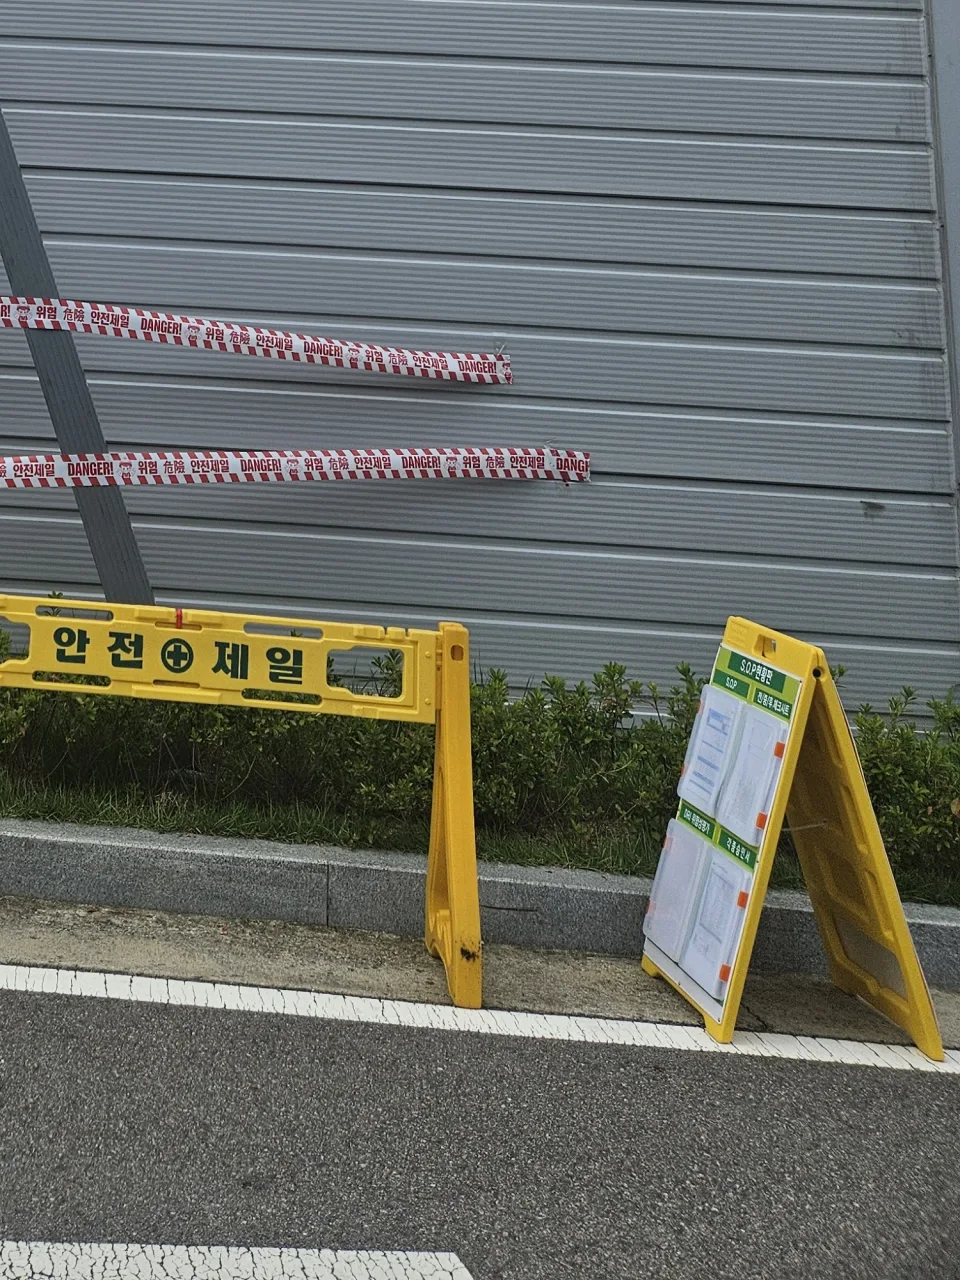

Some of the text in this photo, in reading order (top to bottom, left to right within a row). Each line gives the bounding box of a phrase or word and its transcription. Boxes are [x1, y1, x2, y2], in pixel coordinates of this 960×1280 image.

[36, 306, 57, 320] 위험
[63, 308, 84, 322] 危險
[90, 310, 130, 329] 안전제일
[140, 317, 182, 335] DANGER!
[205, 327, 224, 342] 위험
[229, 330, 250, 345] 危險
[256, 333, 293, 351] 안전제일
[303, 340, 342, 358] DANGER!
[365, 349, 383, 363] 위험
[388, 352, 408, 366] 危險
[412, 355, 449, 371] 안전제일
[458, 360, 496, 374] DANGER!
[13, 463, 55, 478] 안전제일
[67, 461, 113, 477] DANGER!
[138, 460, 157, 475] 위험
[163, 460, 186, 474] 危險
[190, 459, 229, 474] 안전제일
[240, 458, 282, 472] DANGER!
[304, 457, 323, 471] 위험
[328, 457, 349, 471] 危險
[354, 456, 392, 470] 안전제일
[402, 456, 441, 469] DANGER!
[462, 455, 480, 469] 위험
[485, 455, 505, 469] 危險
[510, 456, 545, 470] 안전제일
